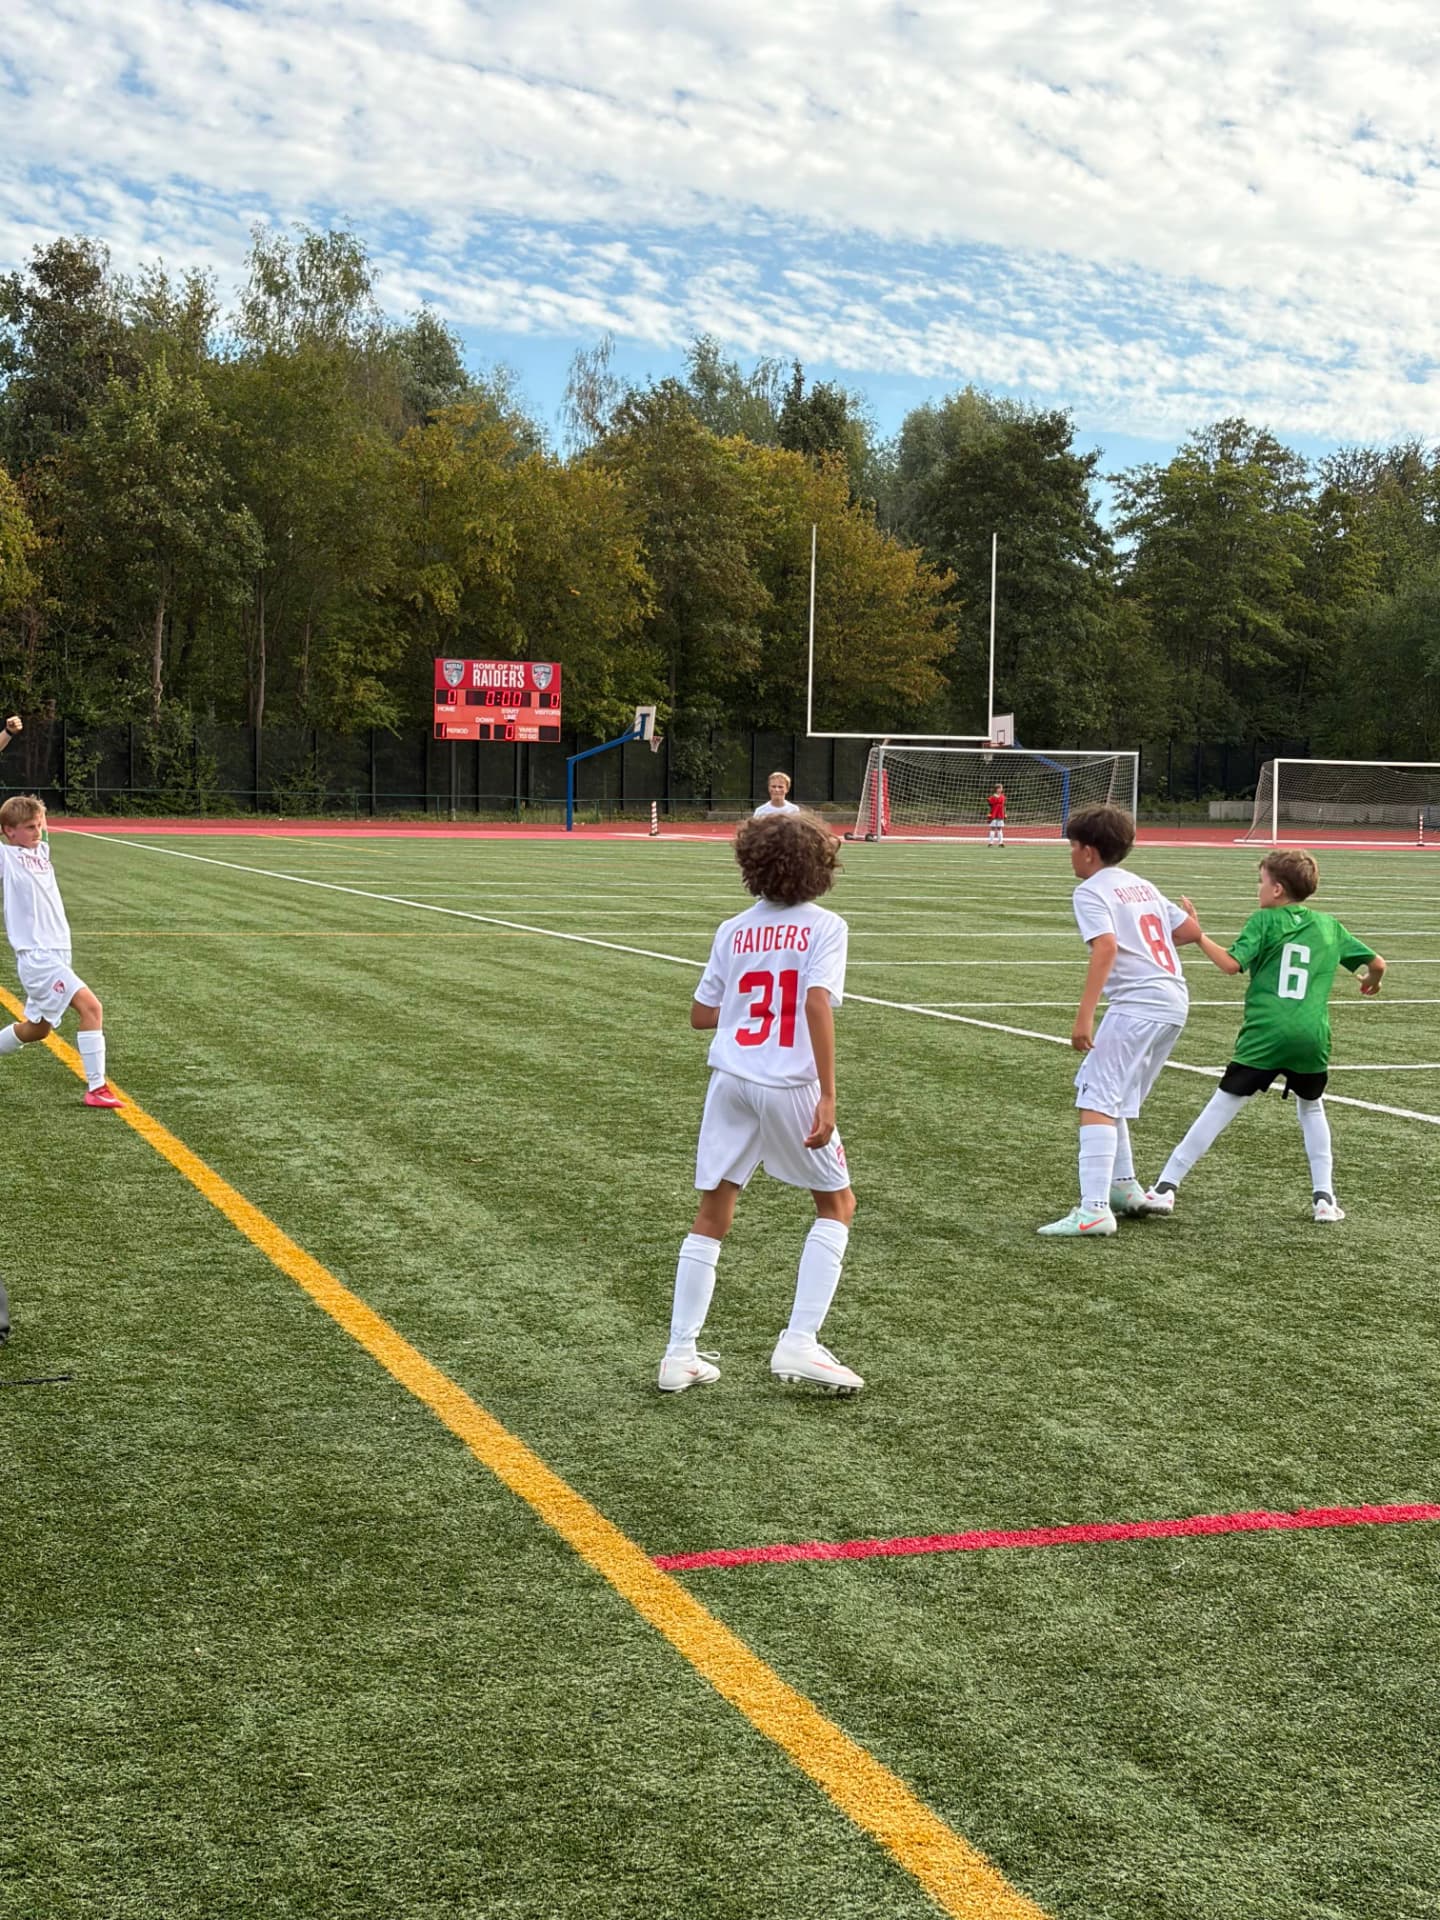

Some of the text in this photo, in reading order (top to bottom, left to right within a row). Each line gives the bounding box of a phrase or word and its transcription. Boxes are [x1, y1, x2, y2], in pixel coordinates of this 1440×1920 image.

[473, 669, 525, 688] RAIDERS
[447, 689, 457, 704] 0
[550, 693, 560, 708] 0
[733, 924, 811, 955] RAIDERS
[1139, 913, 1176, 976] 8
[1277, 943, 1311, 1000] 6
[734, 968, 799, 1048] 31
